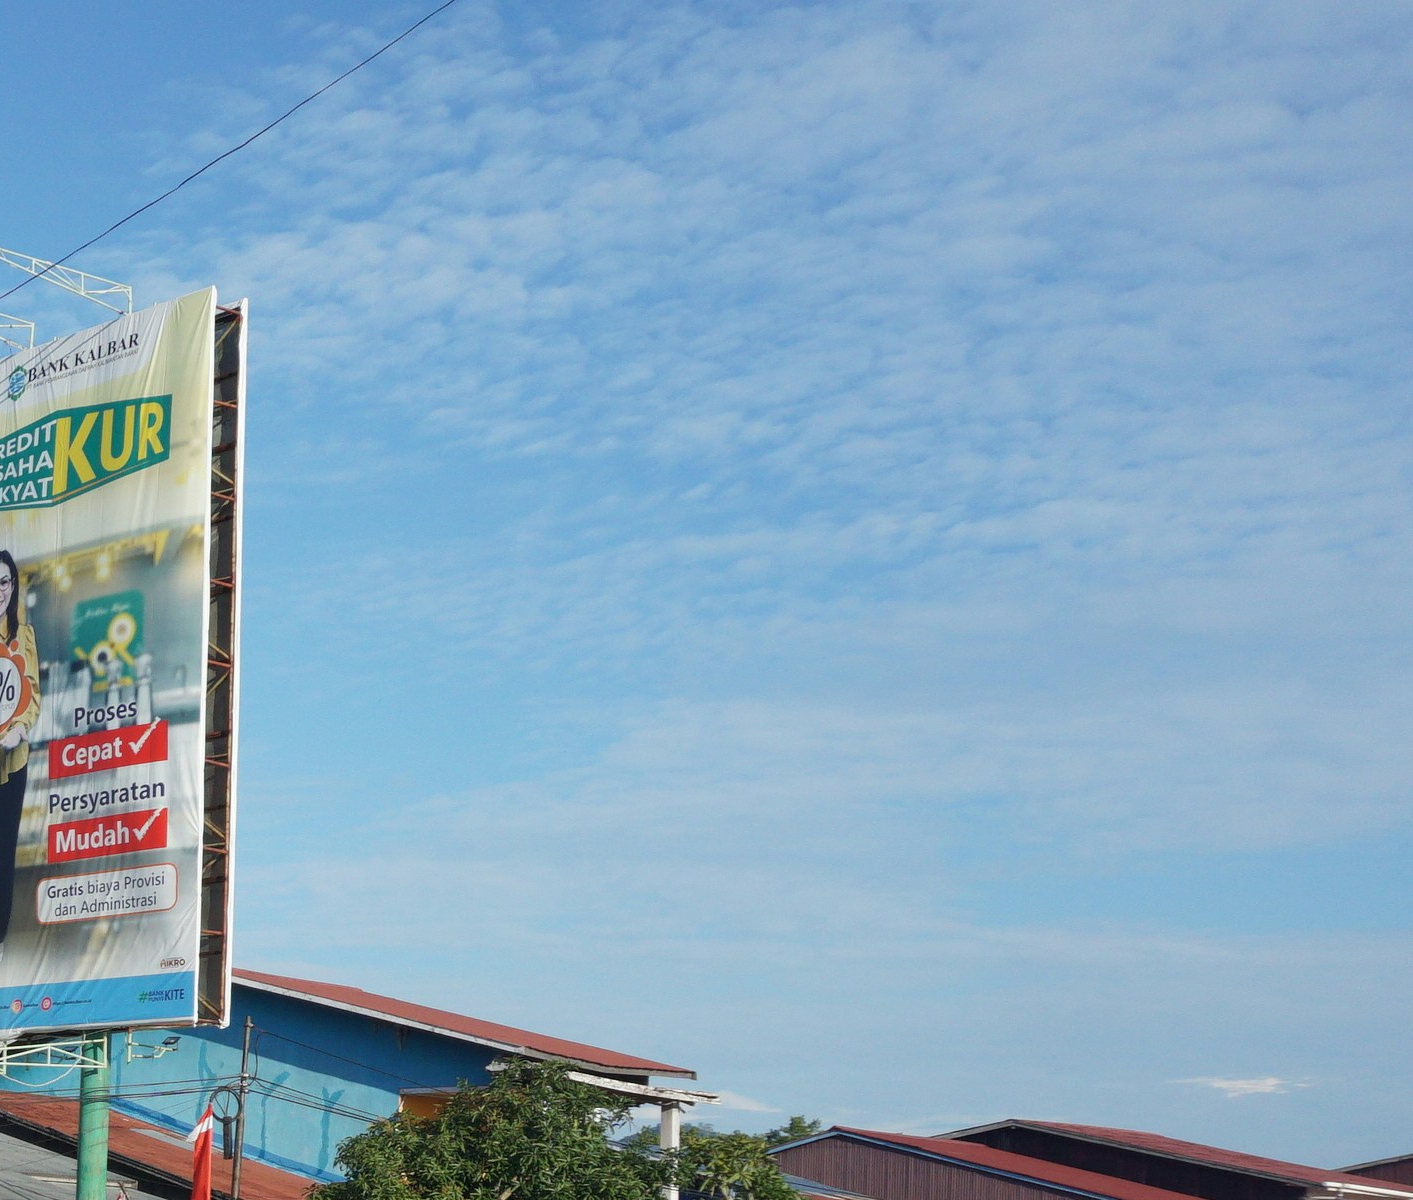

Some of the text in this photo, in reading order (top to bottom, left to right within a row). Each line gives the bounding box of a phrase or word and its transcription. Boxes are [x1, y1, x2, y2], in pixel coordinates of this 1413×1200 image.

[28, 333, 139, 382] BANK KALBAR
[52, 401, 165, 496] KUR
[74, 702, 138, 728] Proses
[61, 736, 123, 770] Cepat
[49, 782, 165, 814] Persyaratan
[55, 820, 130, 854] Mudah
[47, 871, 165, 899] Gratis biaya Provisi
[54, 891, 157, 917] dan Administrasi
[165, 988, 184, 1001] KITE
